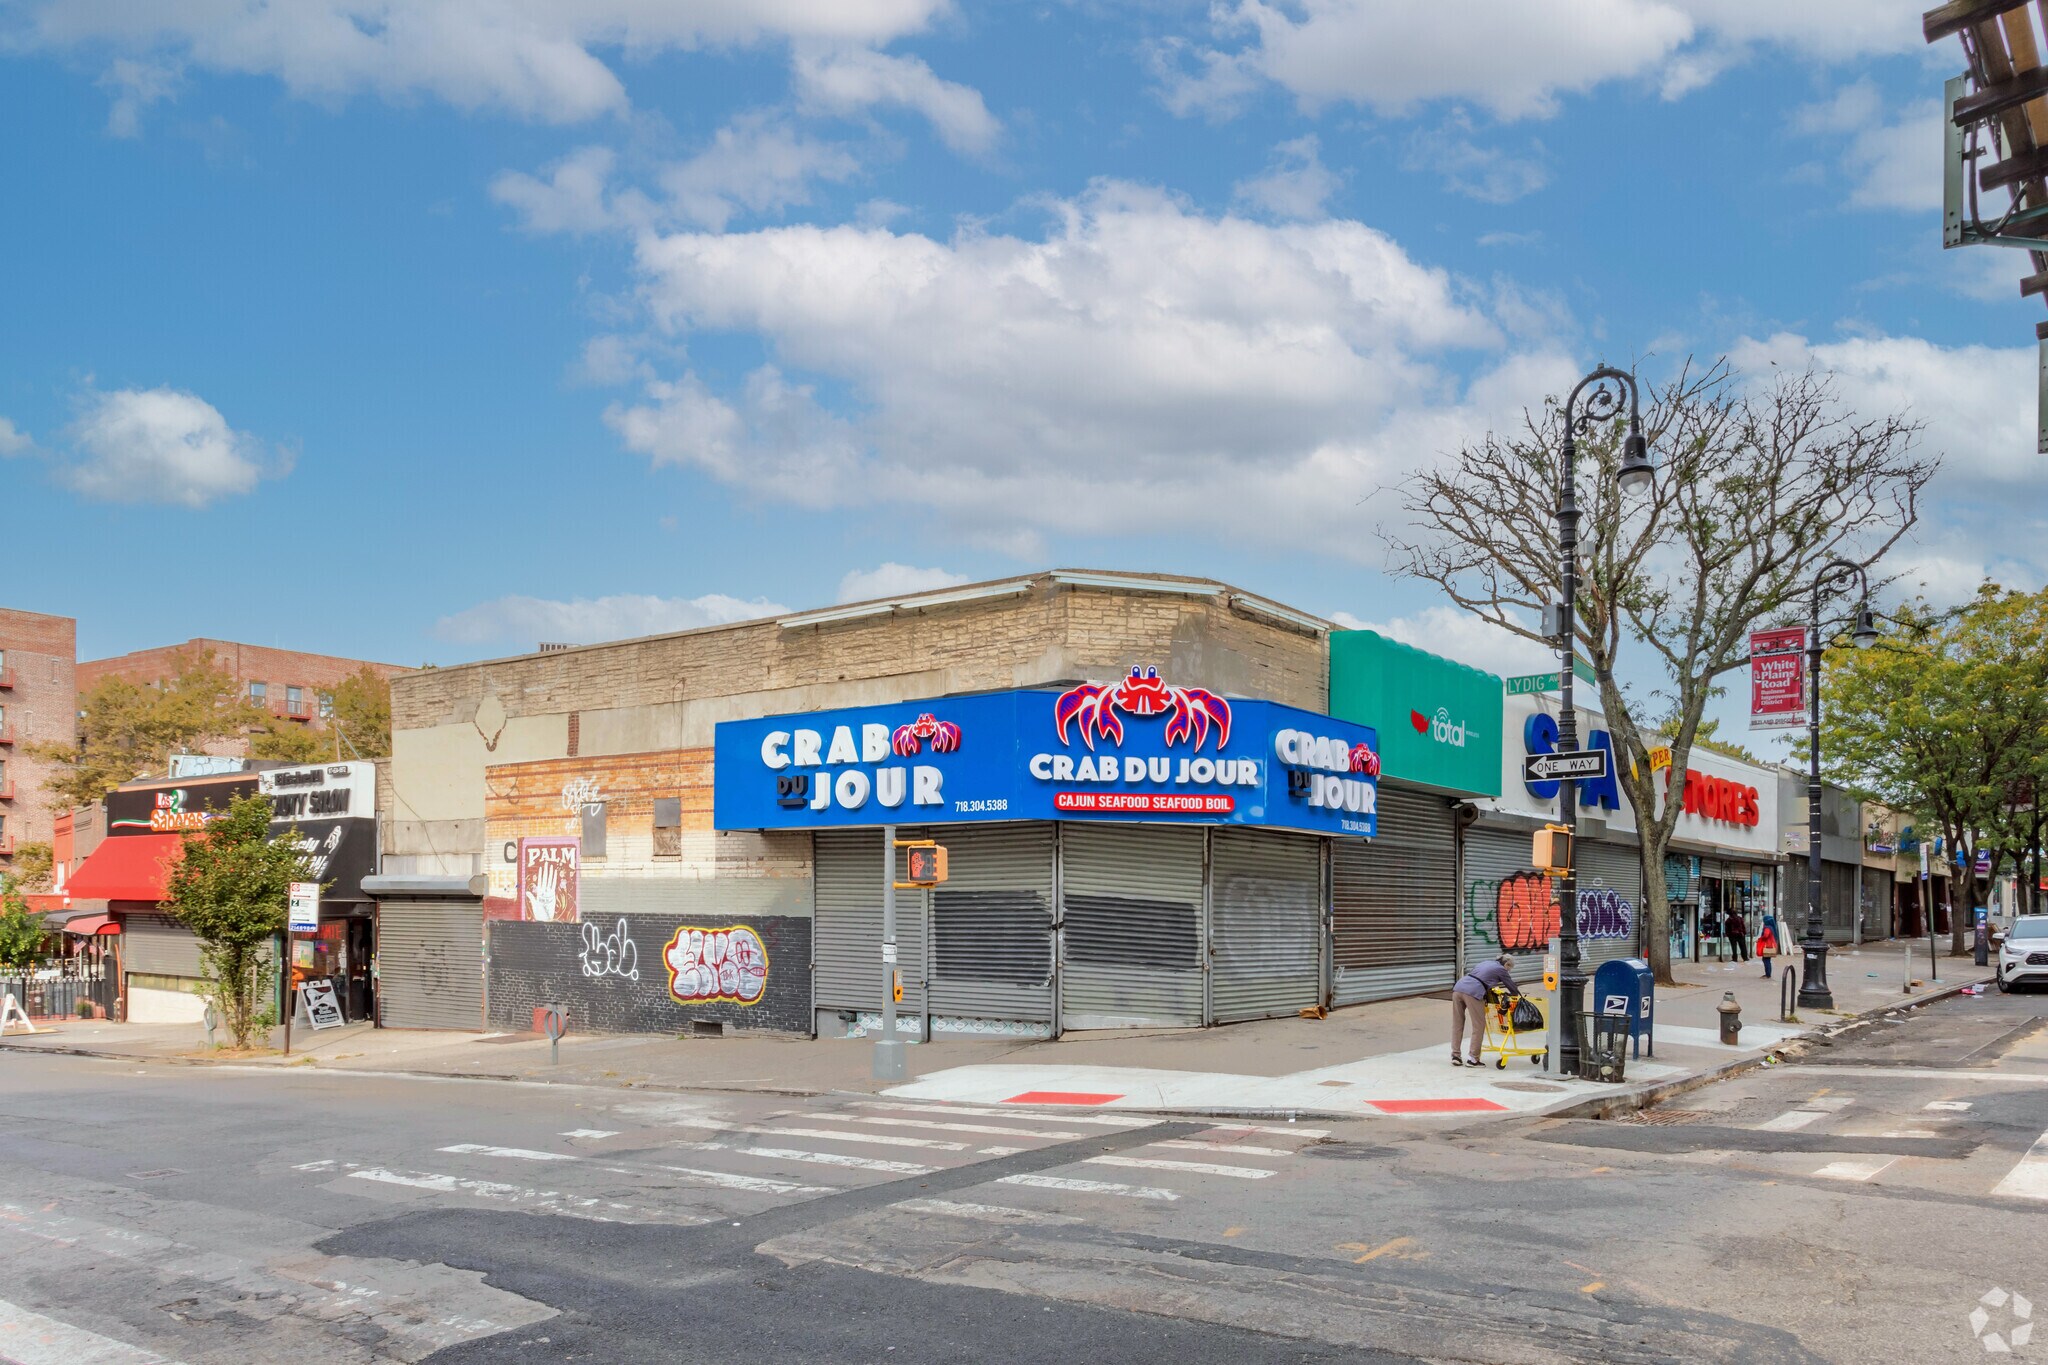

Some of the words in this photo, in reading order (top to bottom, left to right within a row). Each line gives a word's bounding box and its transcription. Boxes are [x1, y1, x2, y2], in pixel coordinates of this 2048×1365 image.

[1761, 661, 1796, 670] White
[1761, 670, 1795, 679] Plains
[1508, 676, 1545, 693] LYDIG
[1761, 679, 1790, 688] Road
[1432, 714, 1465, 747] total
[761, 723, 891, 769] CRAB
[1275, 728, 1350, 772] CRAB
[1029, 753, 1119, 782] CRAB
[1124, 757, 1170, 783] DU
[1175, 757, 1258, 785] JOUR
[1537, 762, 1558, 772] ONE
[1570, 759, 1594, 770] WAY
[777, 775, 809, 796] DU
[810, 765, 944, 811] JOUR
[1288, 770, 1312, 789] DU
[1308, 773, 1376, 814] JOUR
[171, 789, 188, 814] 2
[955, 799, 1008, 812] 718.304.5388
[1058, 795, 1095, 807] CAJUN
[1098, 796, 1149, 808] SEAFOOD
[1153, 797, 1202, 809] SEAFOOD
[1206, 798, 1231, 810] BOIL
[528, 848, 576, 869] PALM
